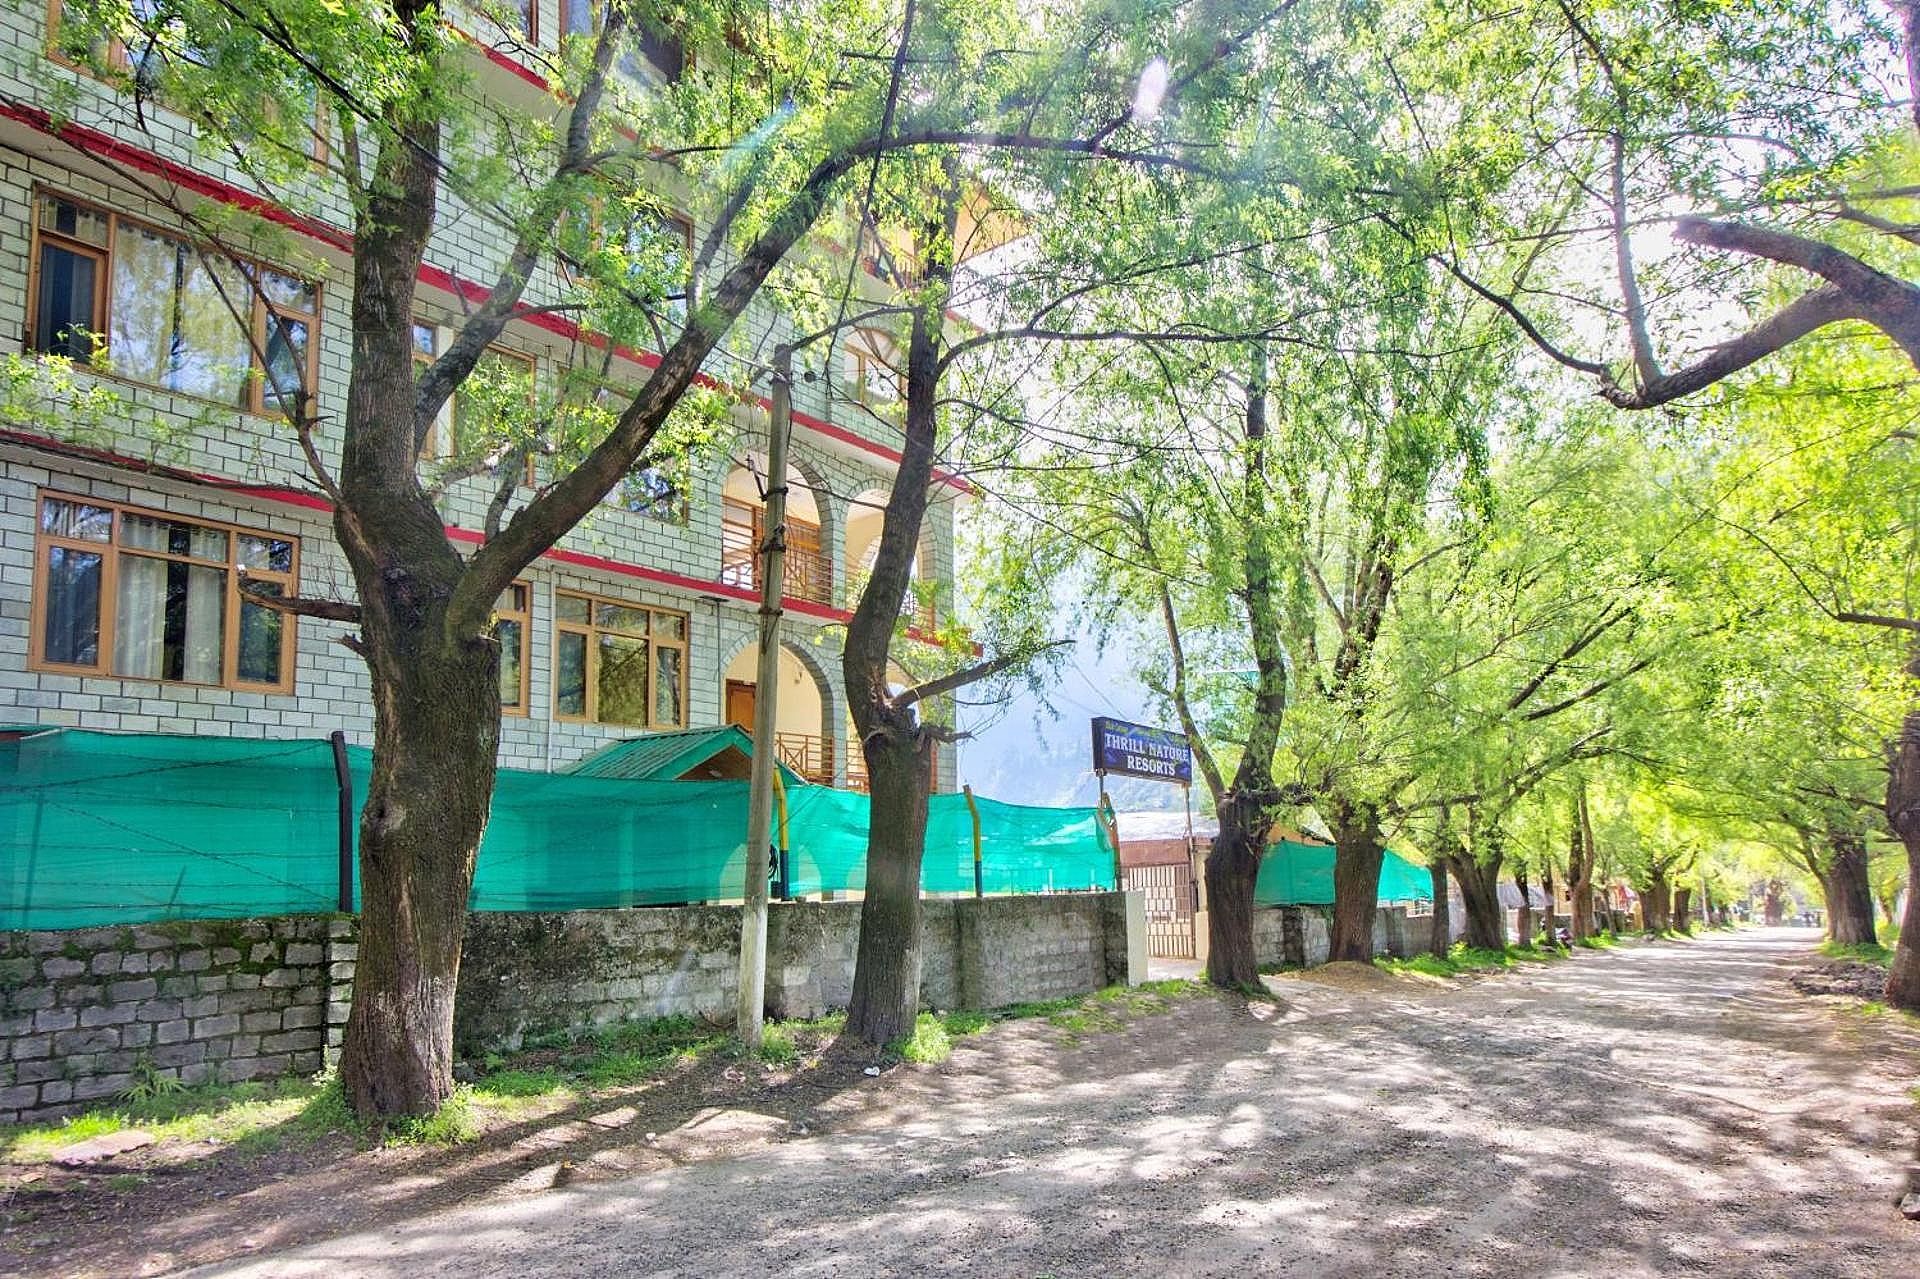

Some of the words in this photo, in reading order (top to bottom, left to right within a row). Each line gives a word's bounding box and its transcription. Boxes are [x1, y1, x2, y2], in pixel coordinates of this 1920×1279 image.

[1105, 733, 1145, 754] THRILL
[1149, 743, 1189, 760] NATURE
[1127, 755, 1176, 776] RESORTS
